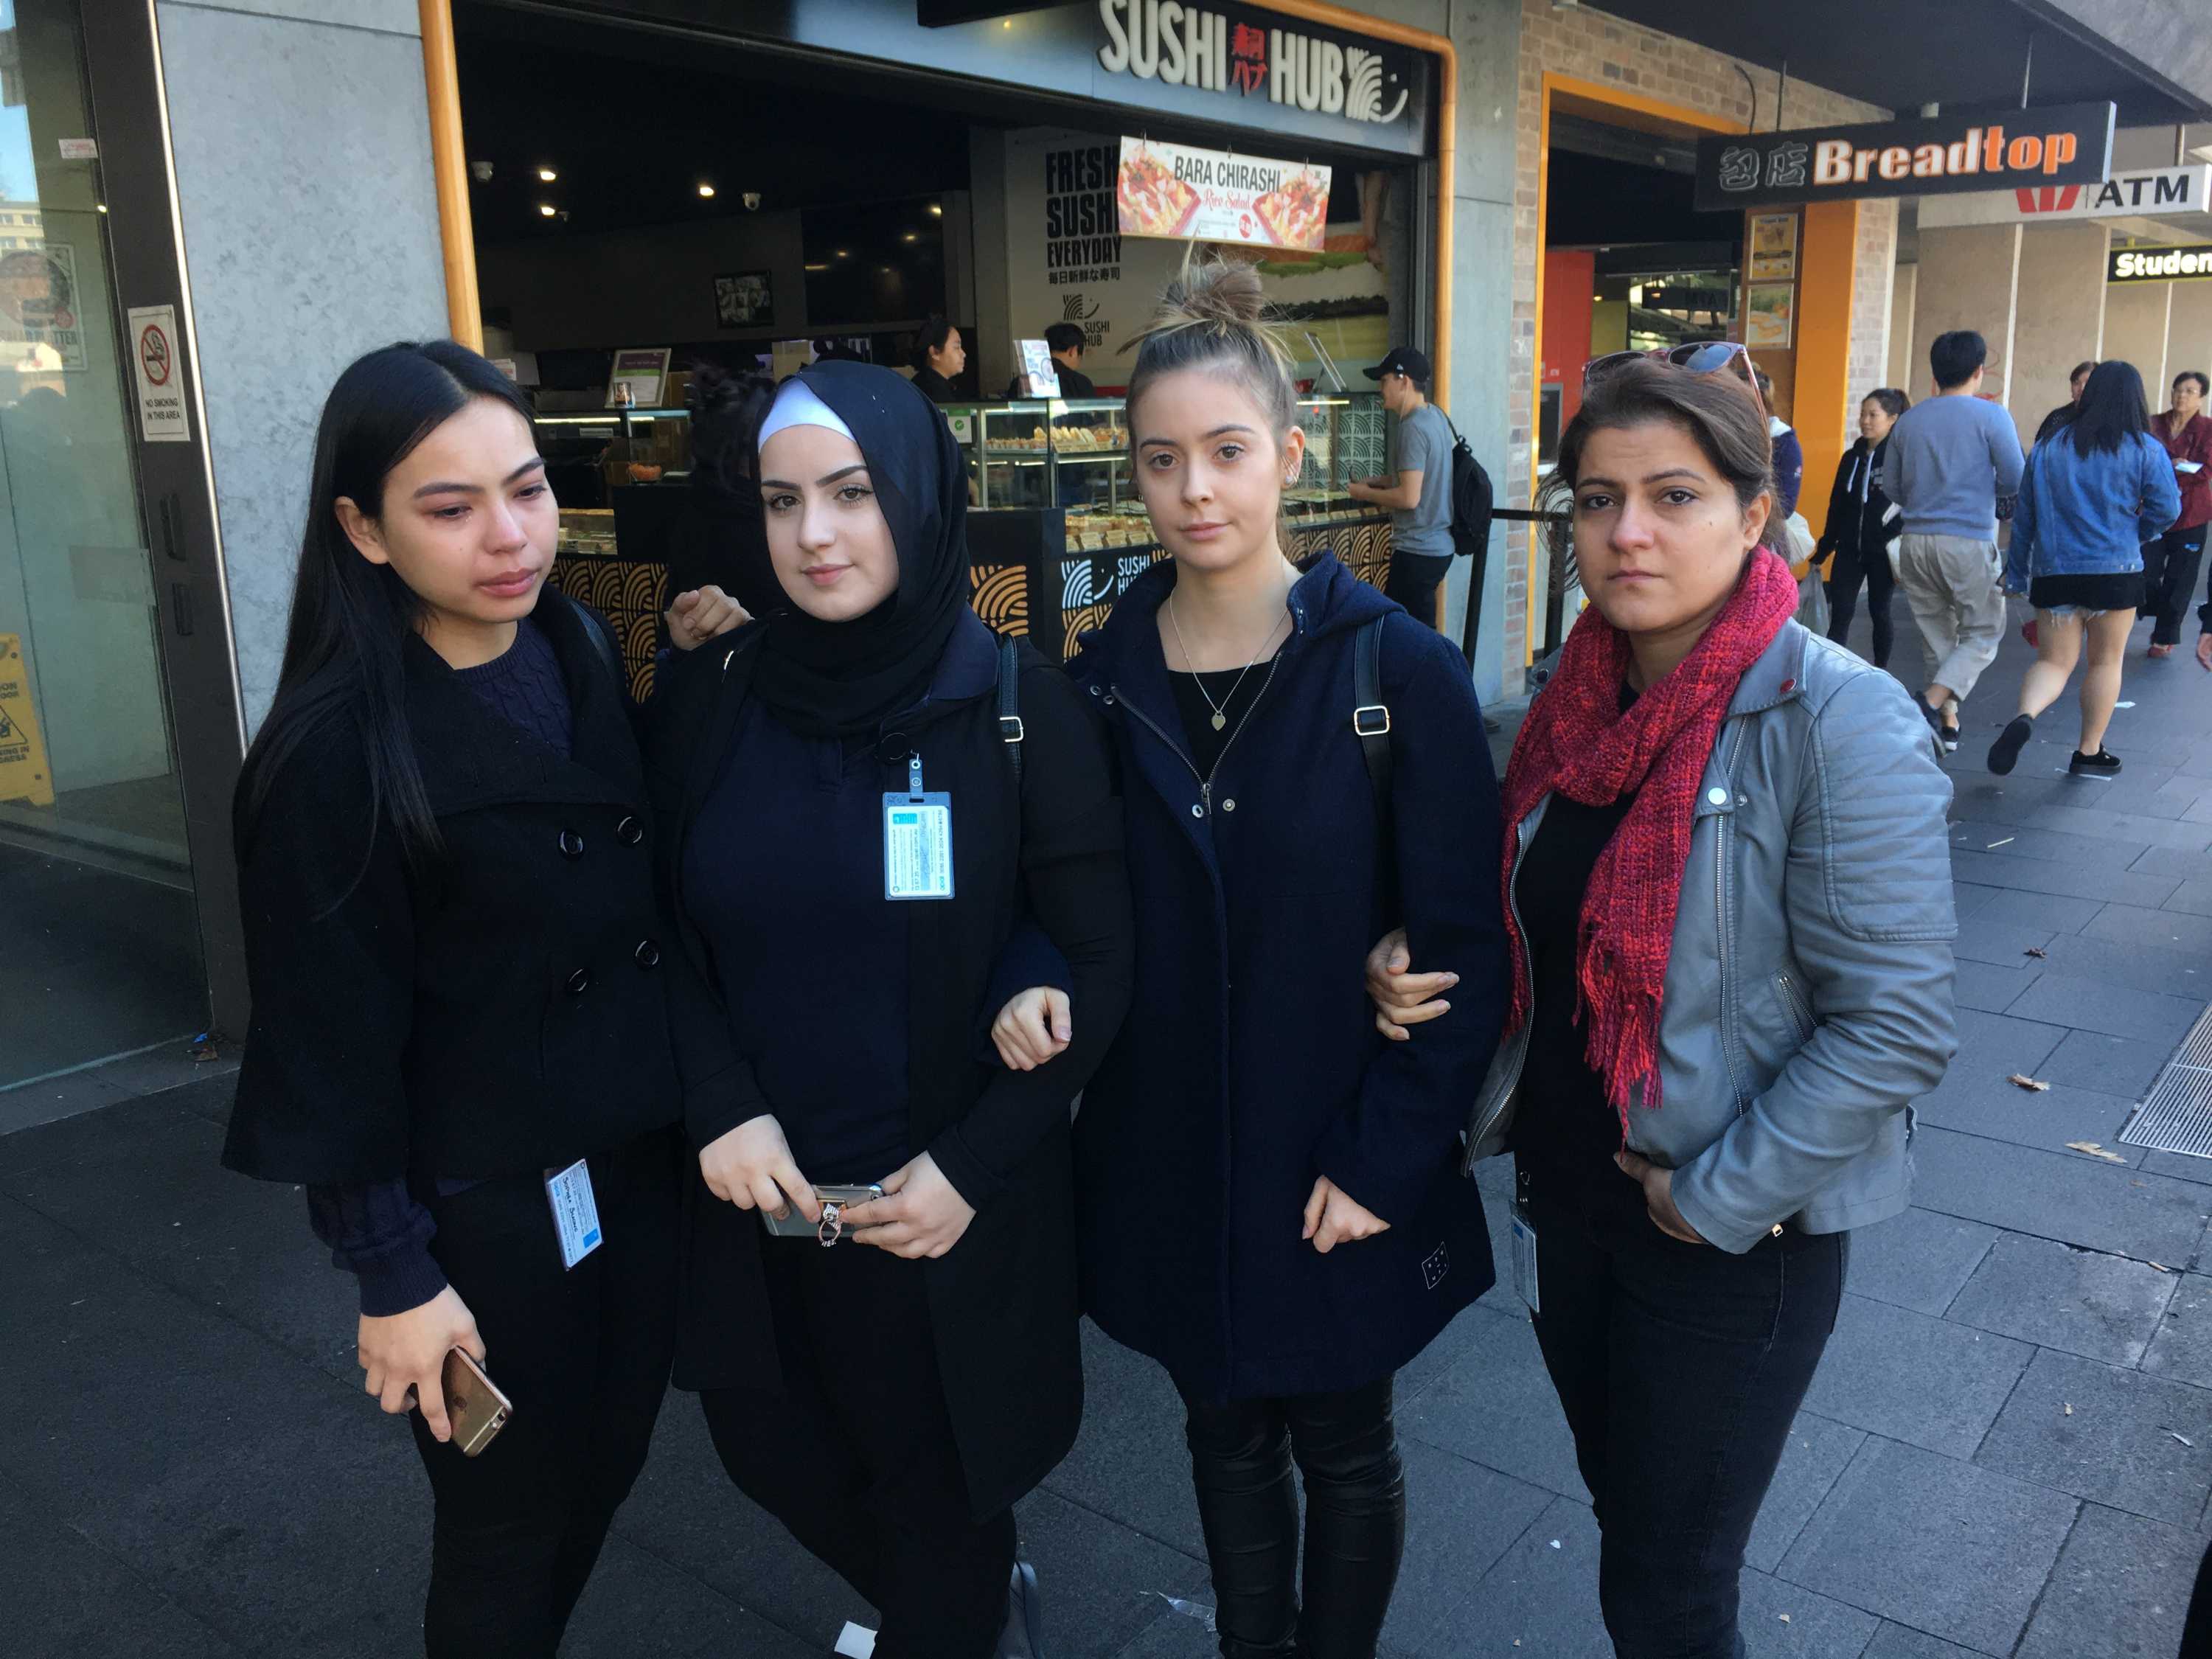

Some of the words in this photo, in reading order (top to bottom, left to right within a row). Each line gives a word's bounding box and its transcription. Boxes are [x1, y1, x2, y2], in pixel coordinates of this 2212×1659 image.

[1099, 0, 1226, 92] SUSHI
[1270, 29, 1344, 113] HUB
[1046, 145, 1119, 195] FRESH
[1814, 125, 2077, 186] Breadtop
[1175, 156, 1212, 185] BARA
[1217, 161, 1281, 193] CHIRASHI
[2095, 174, 2189, 209] ATM
[1046, 190, 1120, 239] SUSHI
[1046, 235, 1122, 268] EVERYDAY
[2115, 250, 2212, 277] Studen
[1084, 321, 1110, 334] SUSHI
[1085, 335, 1103, 347] HUB
[145, 399, 153, 407] NO
[153, 397, 178, 407] SMOKING
[153, 411, 165, 420] THIS
[165, 410, 181, 419] AREA
[1118, 554, 1150, 577] SUSHI
